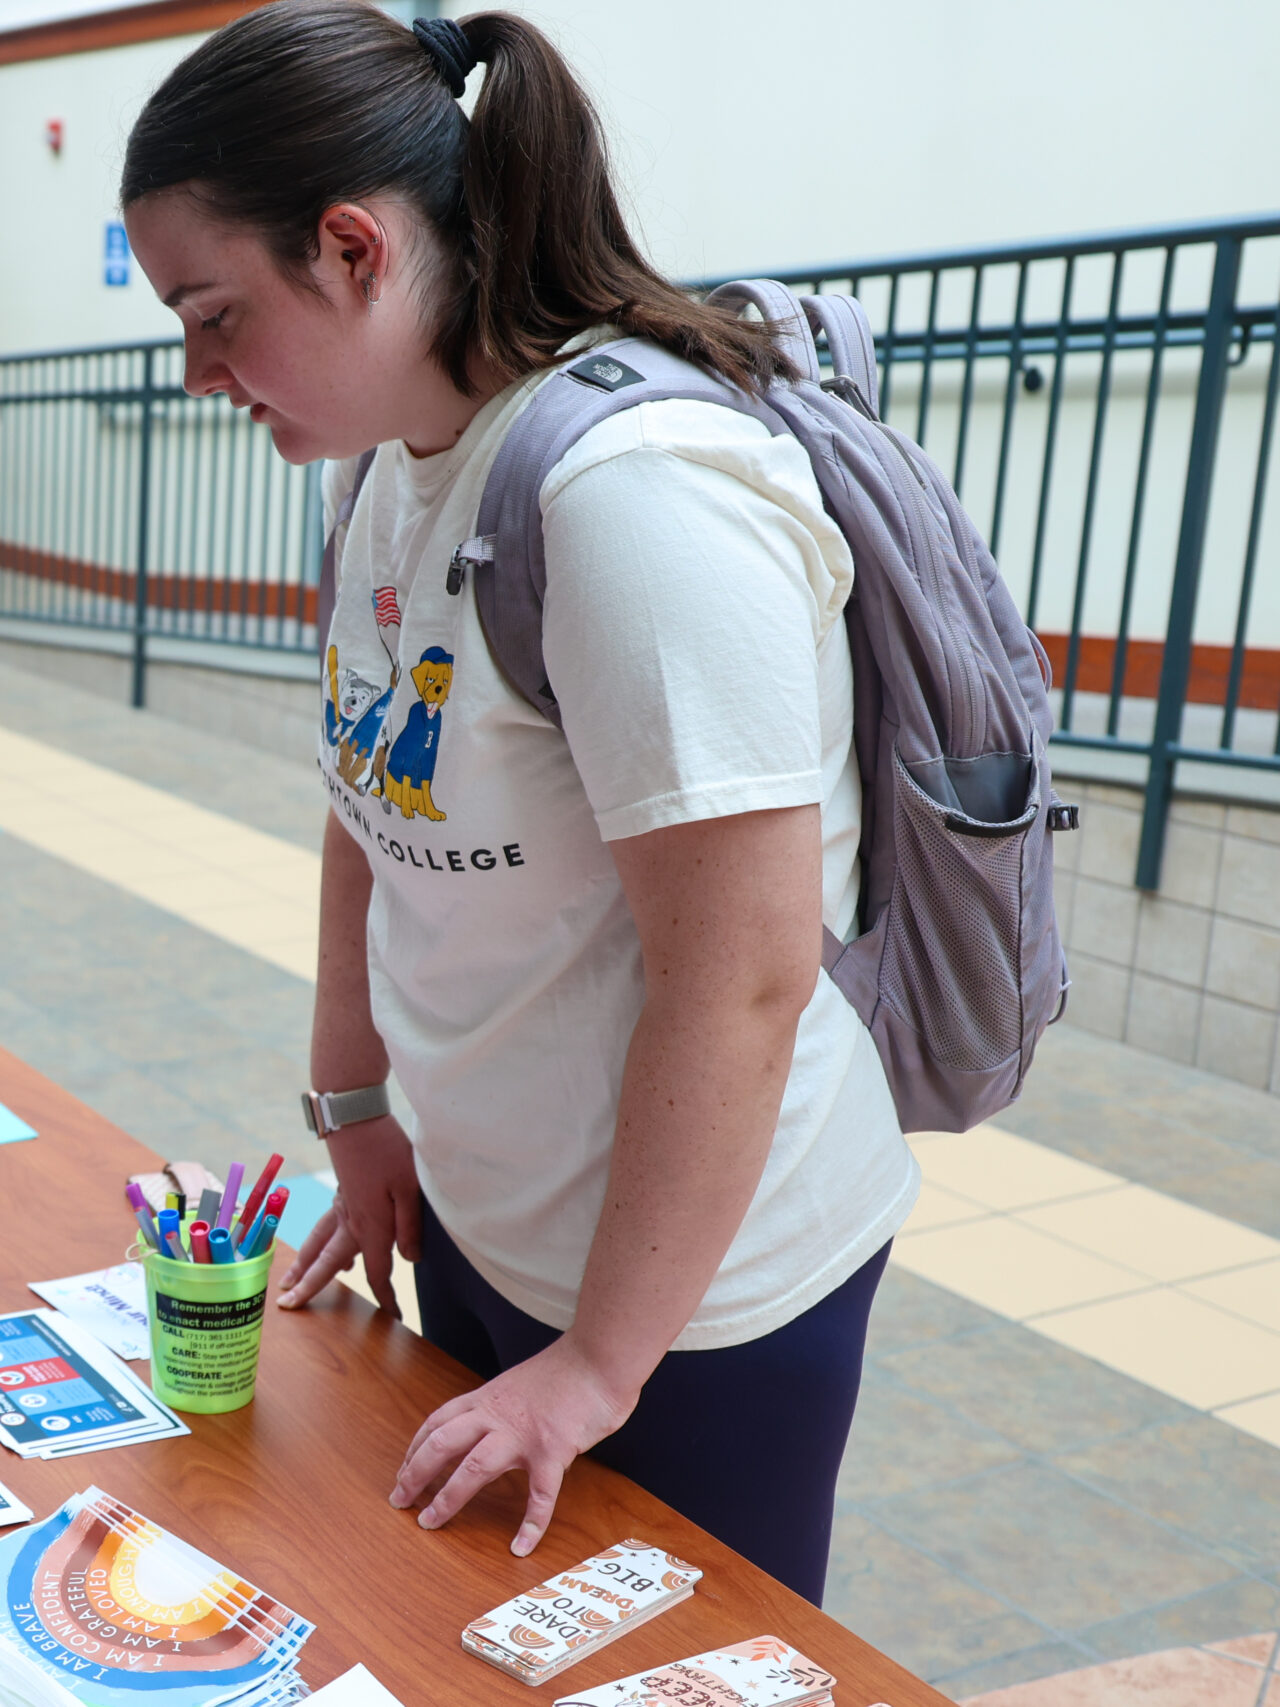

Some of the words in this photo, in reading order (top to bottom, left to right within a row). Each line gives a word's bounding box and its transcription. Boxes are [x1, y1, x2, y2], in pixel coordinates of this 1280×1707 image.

[377, 832, 525, 872] COLLEGE
[171, 1300, 232, 1314] Remember
[236, 1301, 250, 1312] the
[158, 1310, 167, 1320] to
[170, 1314, 200, 1327] enact
[203, 1314, 245, 1328] medical
[162, 1324, 184, 1338] CALL
[172, 1346, 201, 1360] CARE:
[166, 1366, 222, 1380] COOPERATE
[117, 1550, 152, 1614] ENOUGH
[597, 1562, 655, 1592] BIG
[89, 1568, 124, 1618] LOVED
[558, 1575, 634, 1610] DREAM
[67, 1567, 118, 1638] GRATEFUL
[192, 1600, 201, 1615] I
[552, 1597, 586, 1619] TO
[41, 1570, 100, 1654] CONFIDENT
[152, 1606, 184, 1620] AM
[513, 1600, 581, 1639] DARE
[12, 1602, 59, 1652] BRAVE
[122, 1616, 160, 1633] AM
[168, 1627, 180, 1638] I
[122, 1632, 162, 1649] AM
[172, 1641, 183, 1652] I
[54, 1650, 92, 1672] AM
[105, 1648, 144, 1666] AM
[153, 1654, 165, 1667] I
[92, 1667, 109, 1680] I
[640, 1676, 720, 1707] EEP
